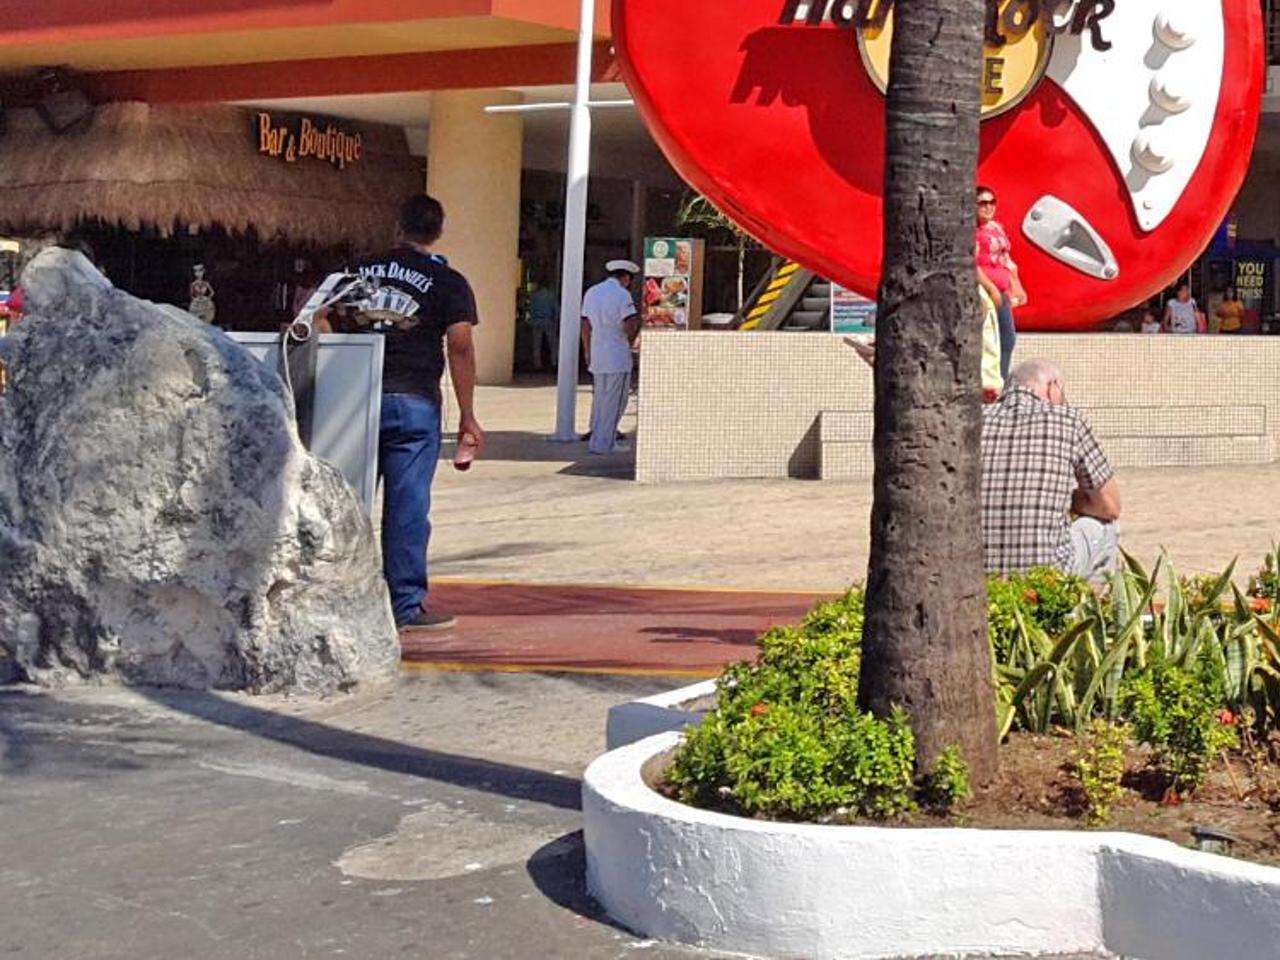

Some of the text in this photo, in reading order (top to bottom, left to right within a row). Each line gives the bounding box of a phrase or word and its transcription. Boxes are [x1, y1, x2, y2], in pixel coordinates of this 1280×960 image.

[259, 112, 361, 169] Bar & Boutique
[1238, 262, 1265, 275] YOU
[1236, 275, 1264, 287] NEED
